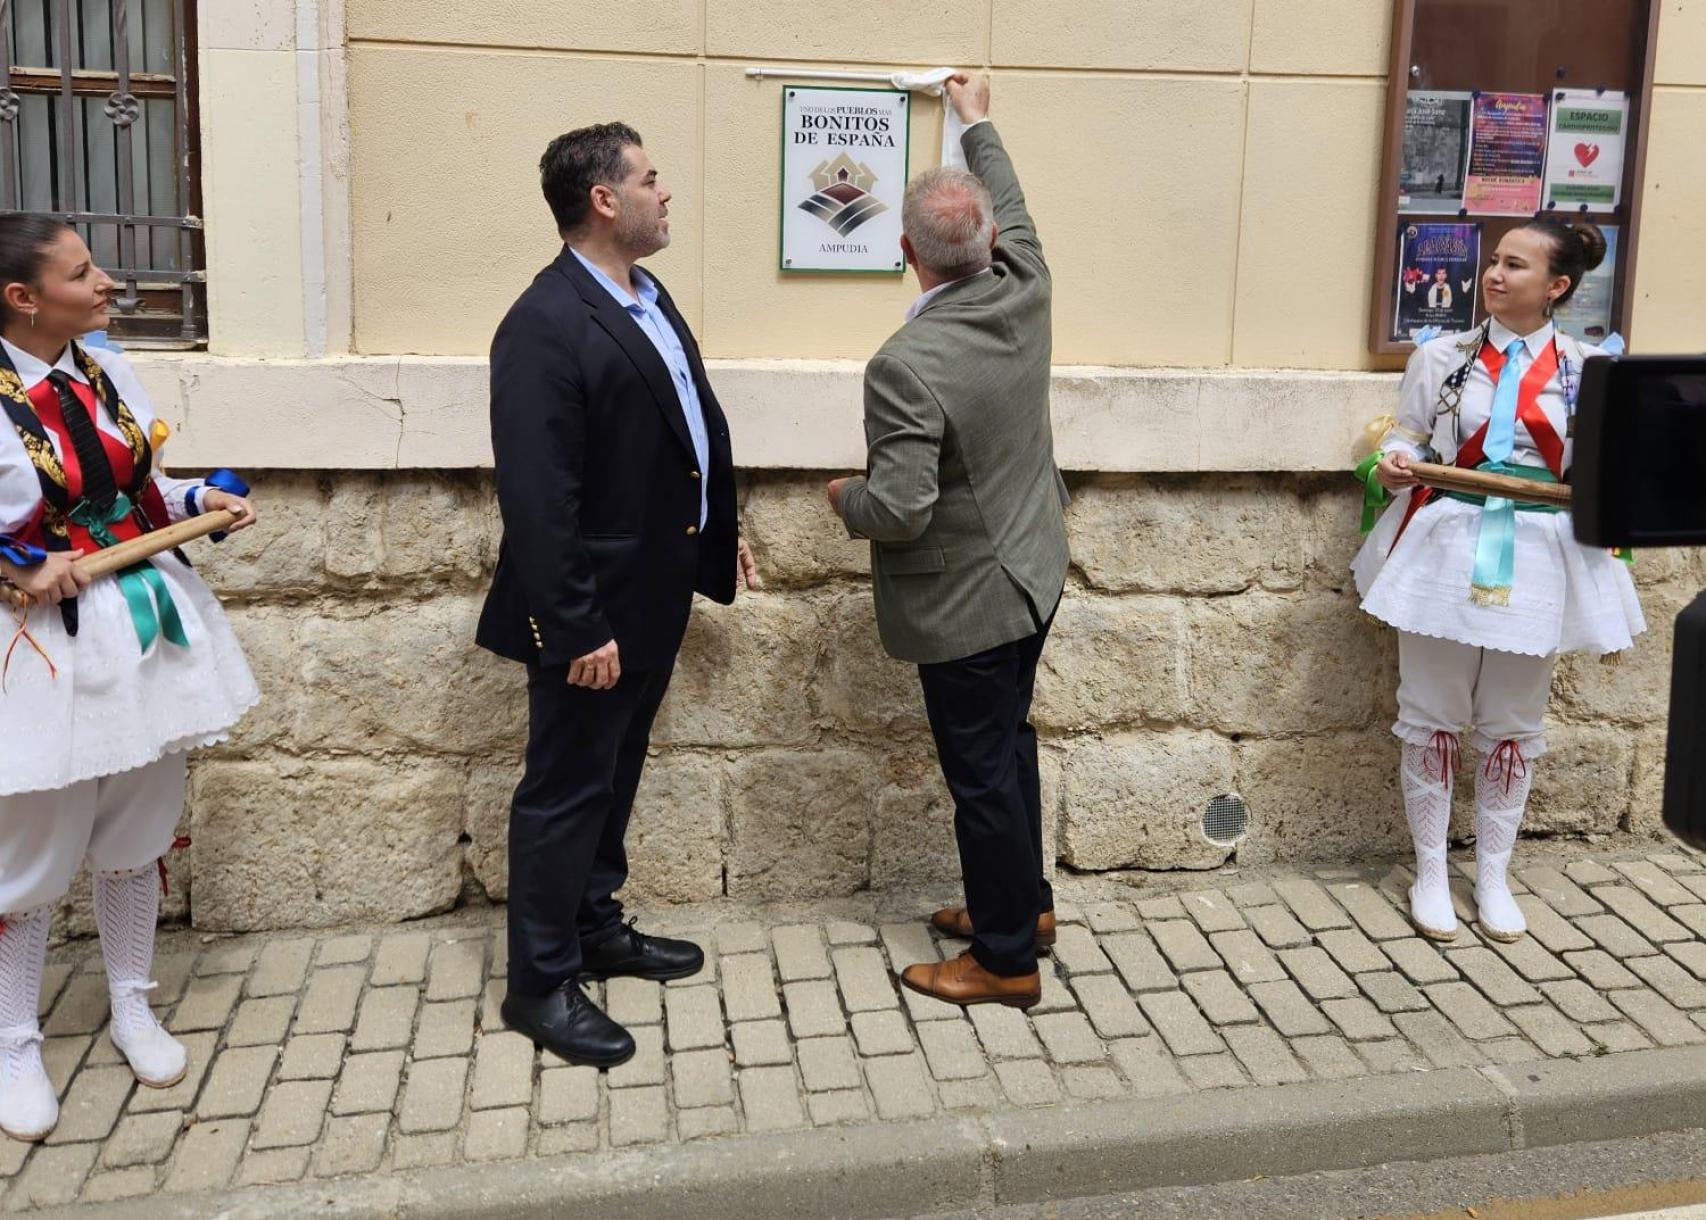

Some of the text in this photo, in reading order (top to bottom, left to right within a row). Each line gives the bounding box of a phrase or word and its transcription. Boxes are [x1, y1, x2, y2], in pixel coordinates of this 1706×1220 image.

[836, 106, 878, 116] PUEBLOS
[1570, 111, 1609, 121] ESPACIO
[801, 115, 890, 131] BONITOS
[794, 131, 895, 147] DE ESPAÑA
[819, 243, 869, 254] AMPUDIA
